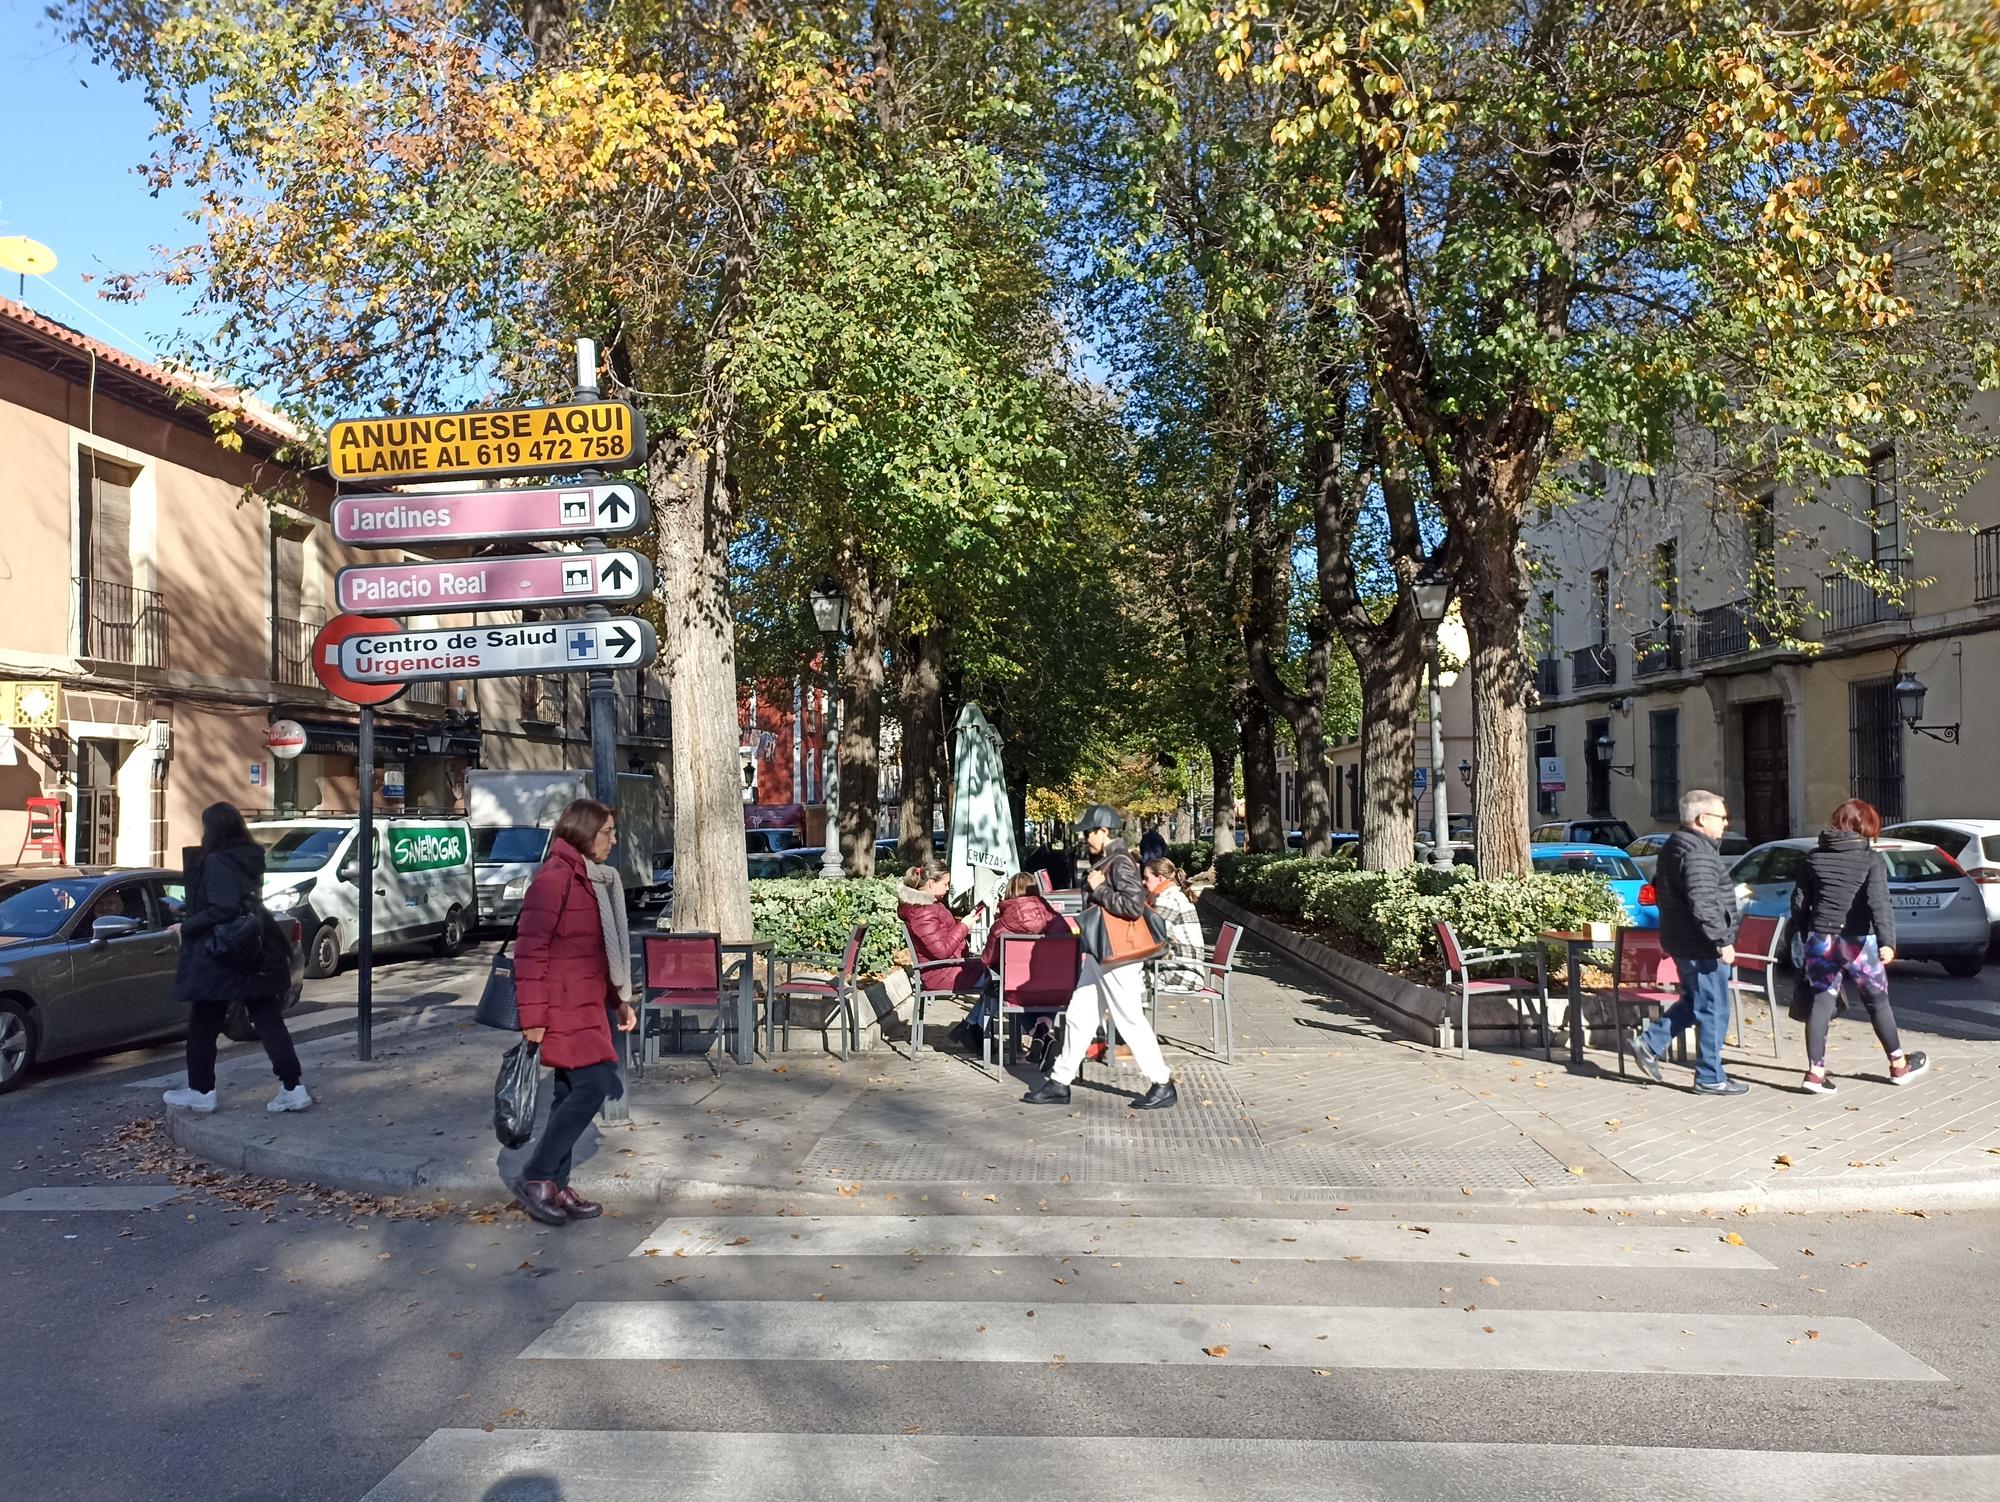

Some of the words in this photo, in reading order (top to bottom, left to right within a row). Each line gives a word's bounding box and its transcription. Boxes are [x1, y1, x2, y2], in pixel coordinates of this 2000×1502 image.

[340, 413, 532, 449] ANUNCIESE
[542, 407, 624, 436] AQUI
[341, 448, 428, 475] LLAME
[436, 445, 470, 468] AL
[477, 442, 521, 464] 619
[528, 438, 573, 461] 472
[580, 435, 625, 458] 758
[350, 505, 452, 531] Jardines
[352, 574, 432, 601] Palacio
[439, 570, 487, 596] Real
[355, 637, 438, 655] Centro
[447, 634, 477, 650] de
[487, 628, 557, 648] Salud
[355, 653, 481, 675] Urgencias
[966, 848, 1004, 868] CRVEZAS
[1896, 895, 1921, 906] 5102
